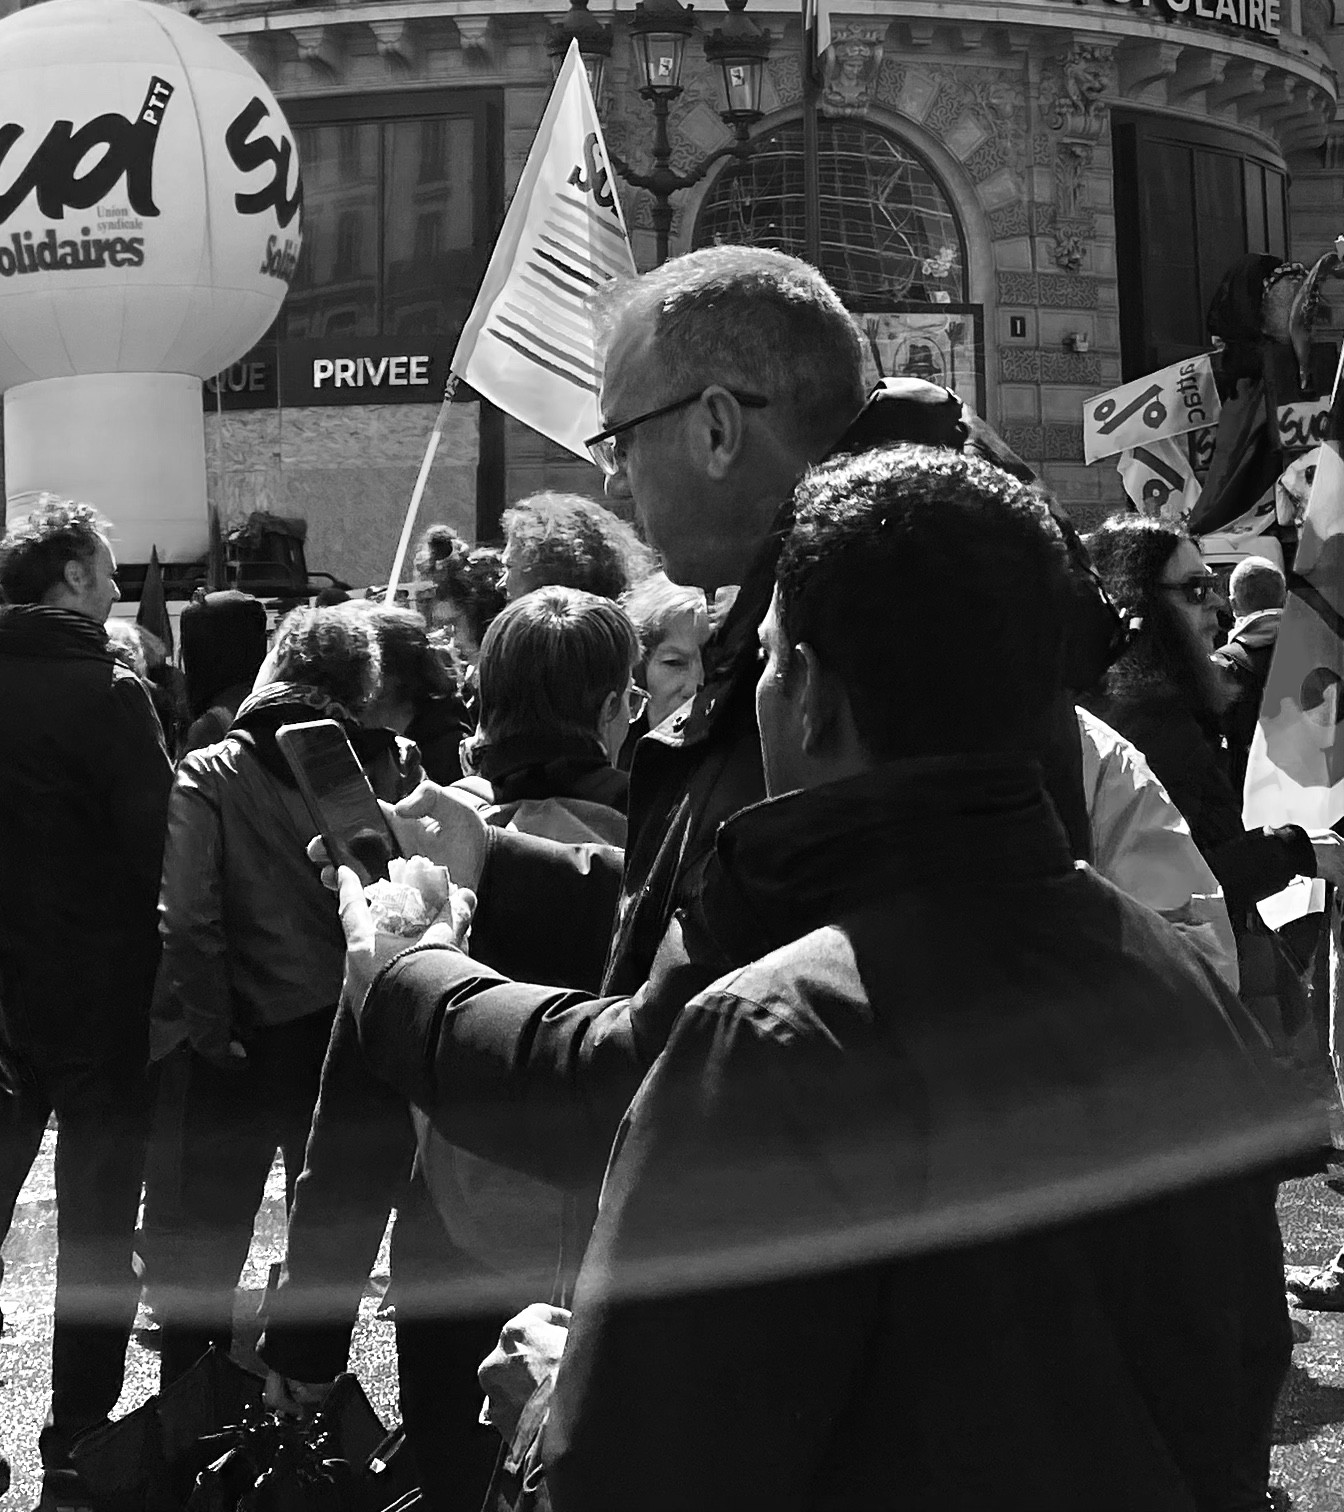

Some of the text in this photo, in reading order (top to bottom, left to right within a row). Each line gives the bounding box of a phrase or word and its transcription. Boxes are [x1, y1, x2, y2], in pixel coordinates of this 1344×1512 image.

[142, 82, 170, 125] PTT
[97, 205, 129, 218] Union
[313, 355, 430, 388] PRIVEE
